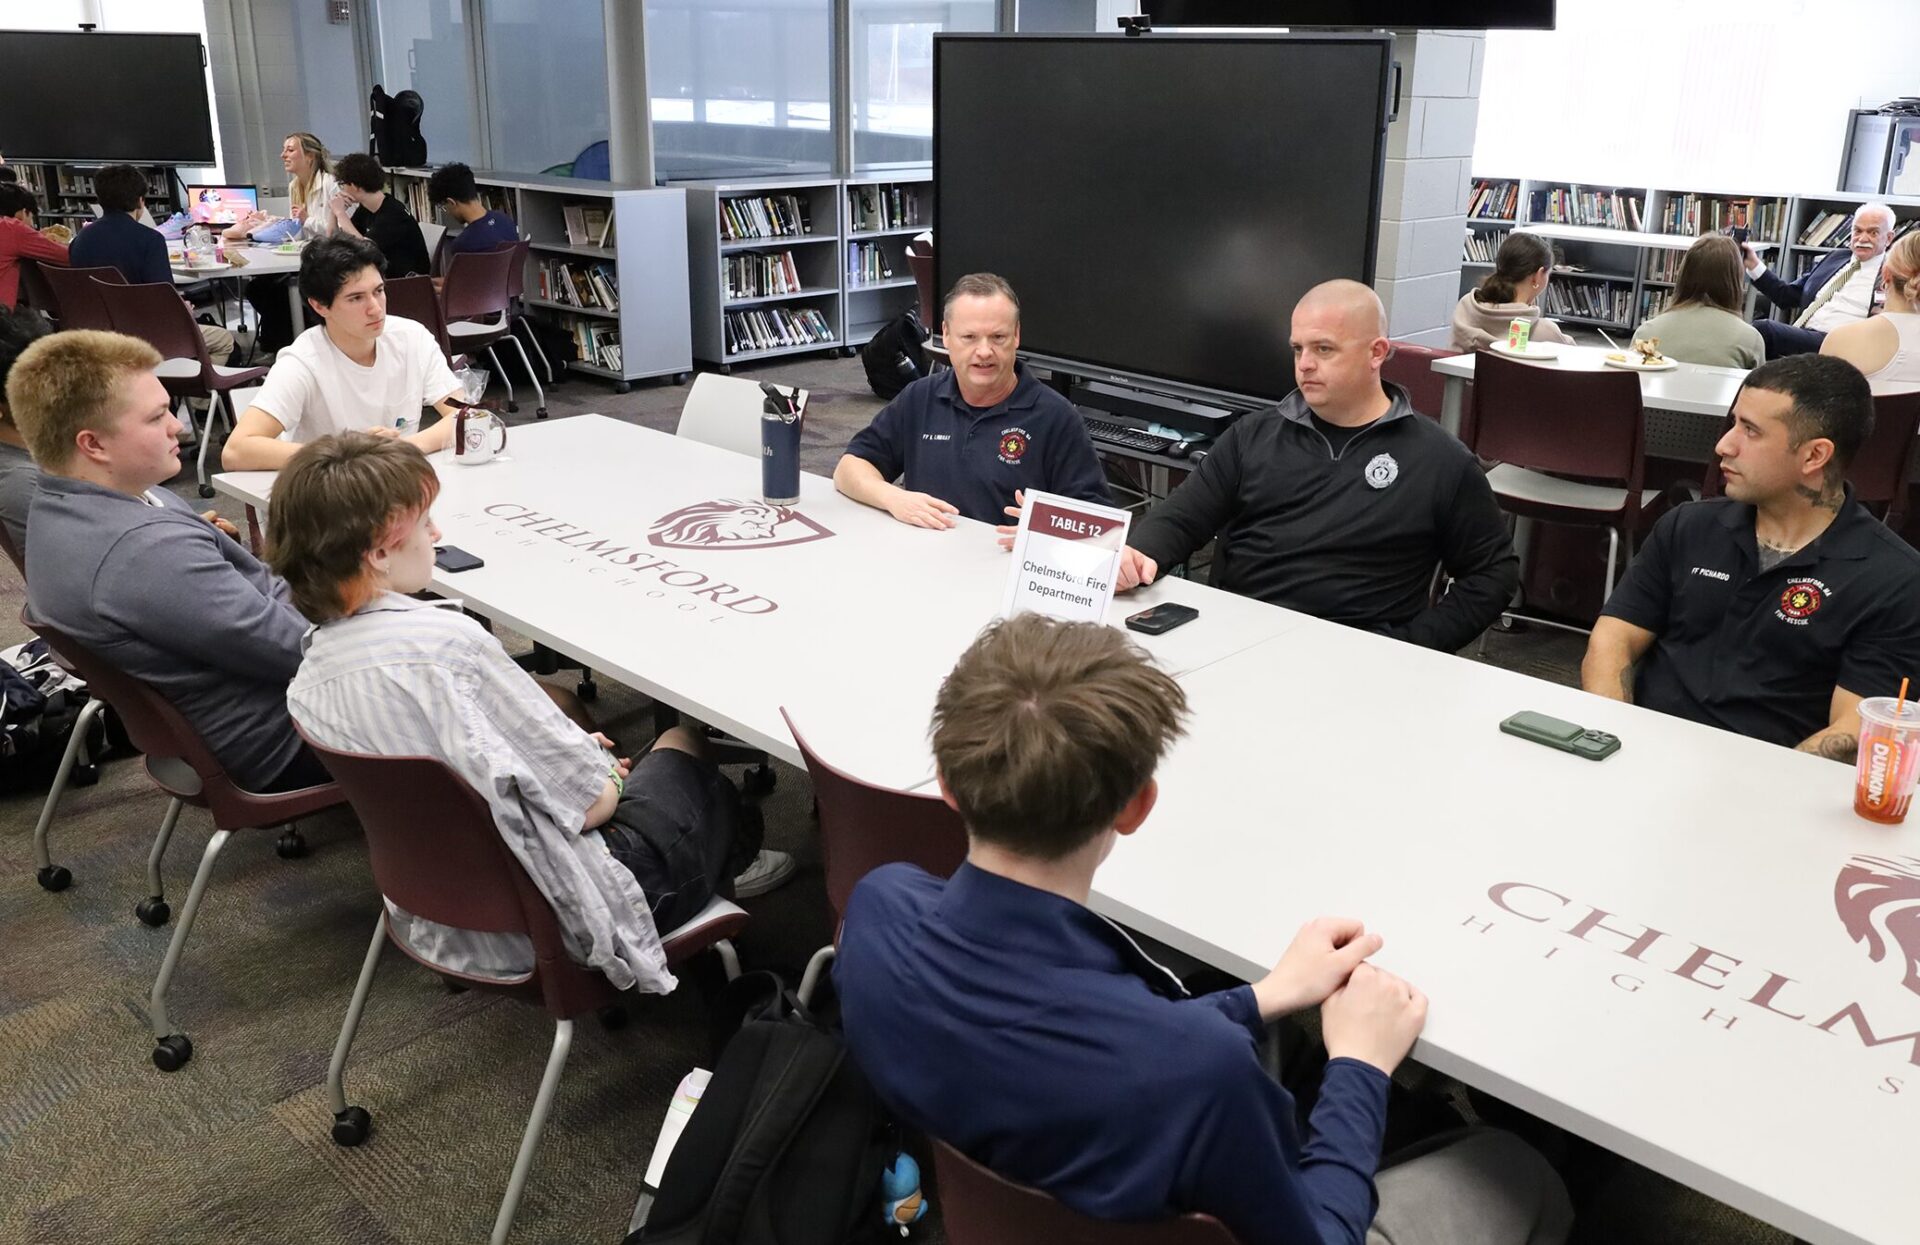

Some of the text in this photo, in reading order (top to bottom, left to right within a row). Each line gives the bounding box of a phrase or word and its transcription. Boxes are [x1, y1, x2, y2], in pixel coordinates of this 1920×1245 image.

[1050, 515, 1102, 537] TABLE 12
[451, 512, 725, 622] HIGH SCHOOL
[483, 503, 779, 615] CHELMSFORD
[1023, 560, 1107, 591] Chelmsford Fire
[1699, 568, 1730, 582] PICHARDO
[1028, 580, 1093, 607] Department
[1461, 915, 1738, 1030] HIGH
